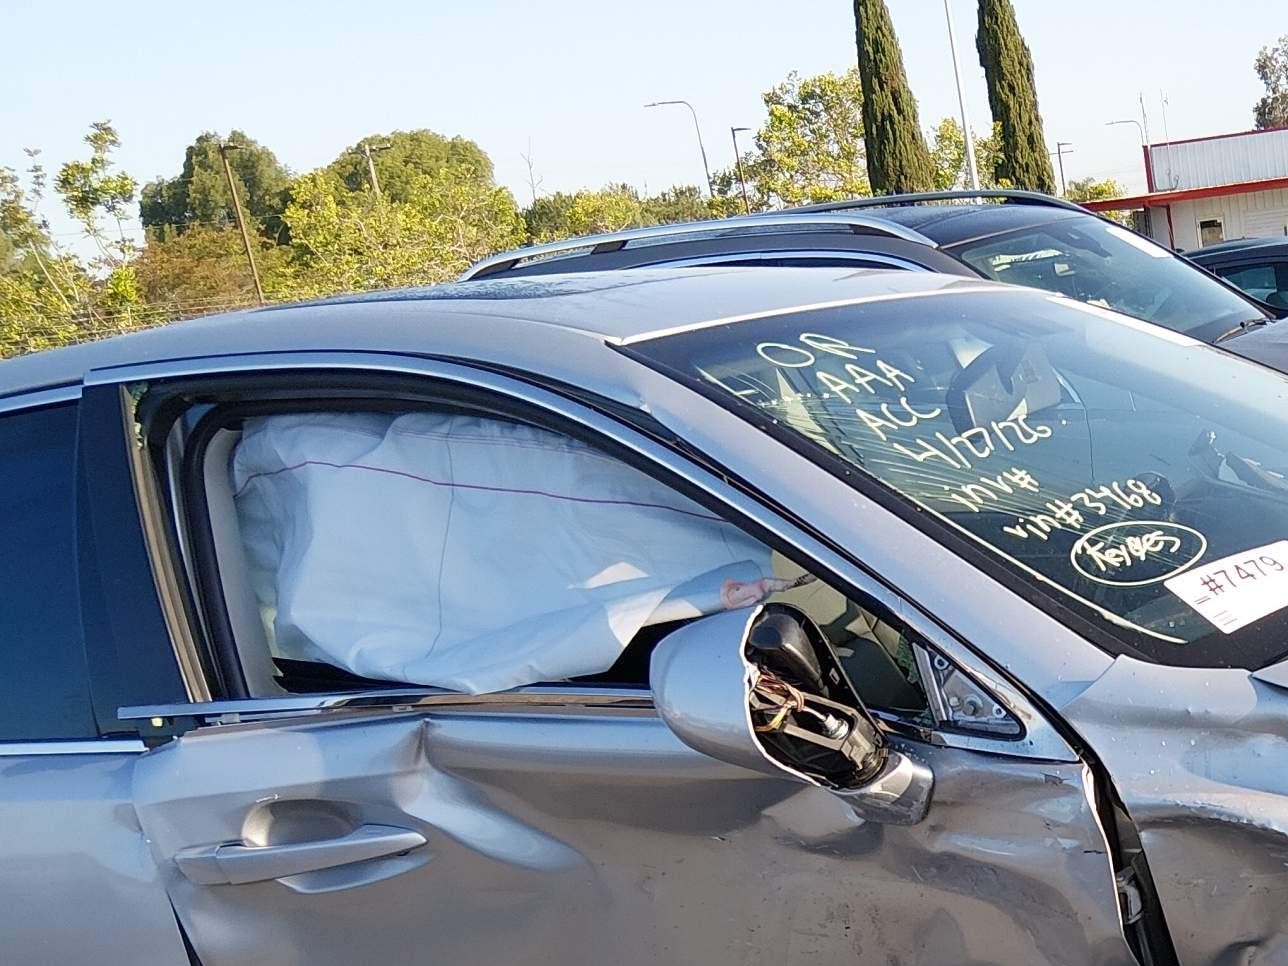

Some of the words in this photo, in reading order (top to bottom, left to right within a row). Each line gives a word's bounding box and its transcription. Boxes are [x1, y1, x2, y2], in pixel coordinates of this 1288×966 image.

[816, 359, 915, 403] AAA
[855, 397, 941, 441] ACC
[1200, 555, 1285, 596] #7479
